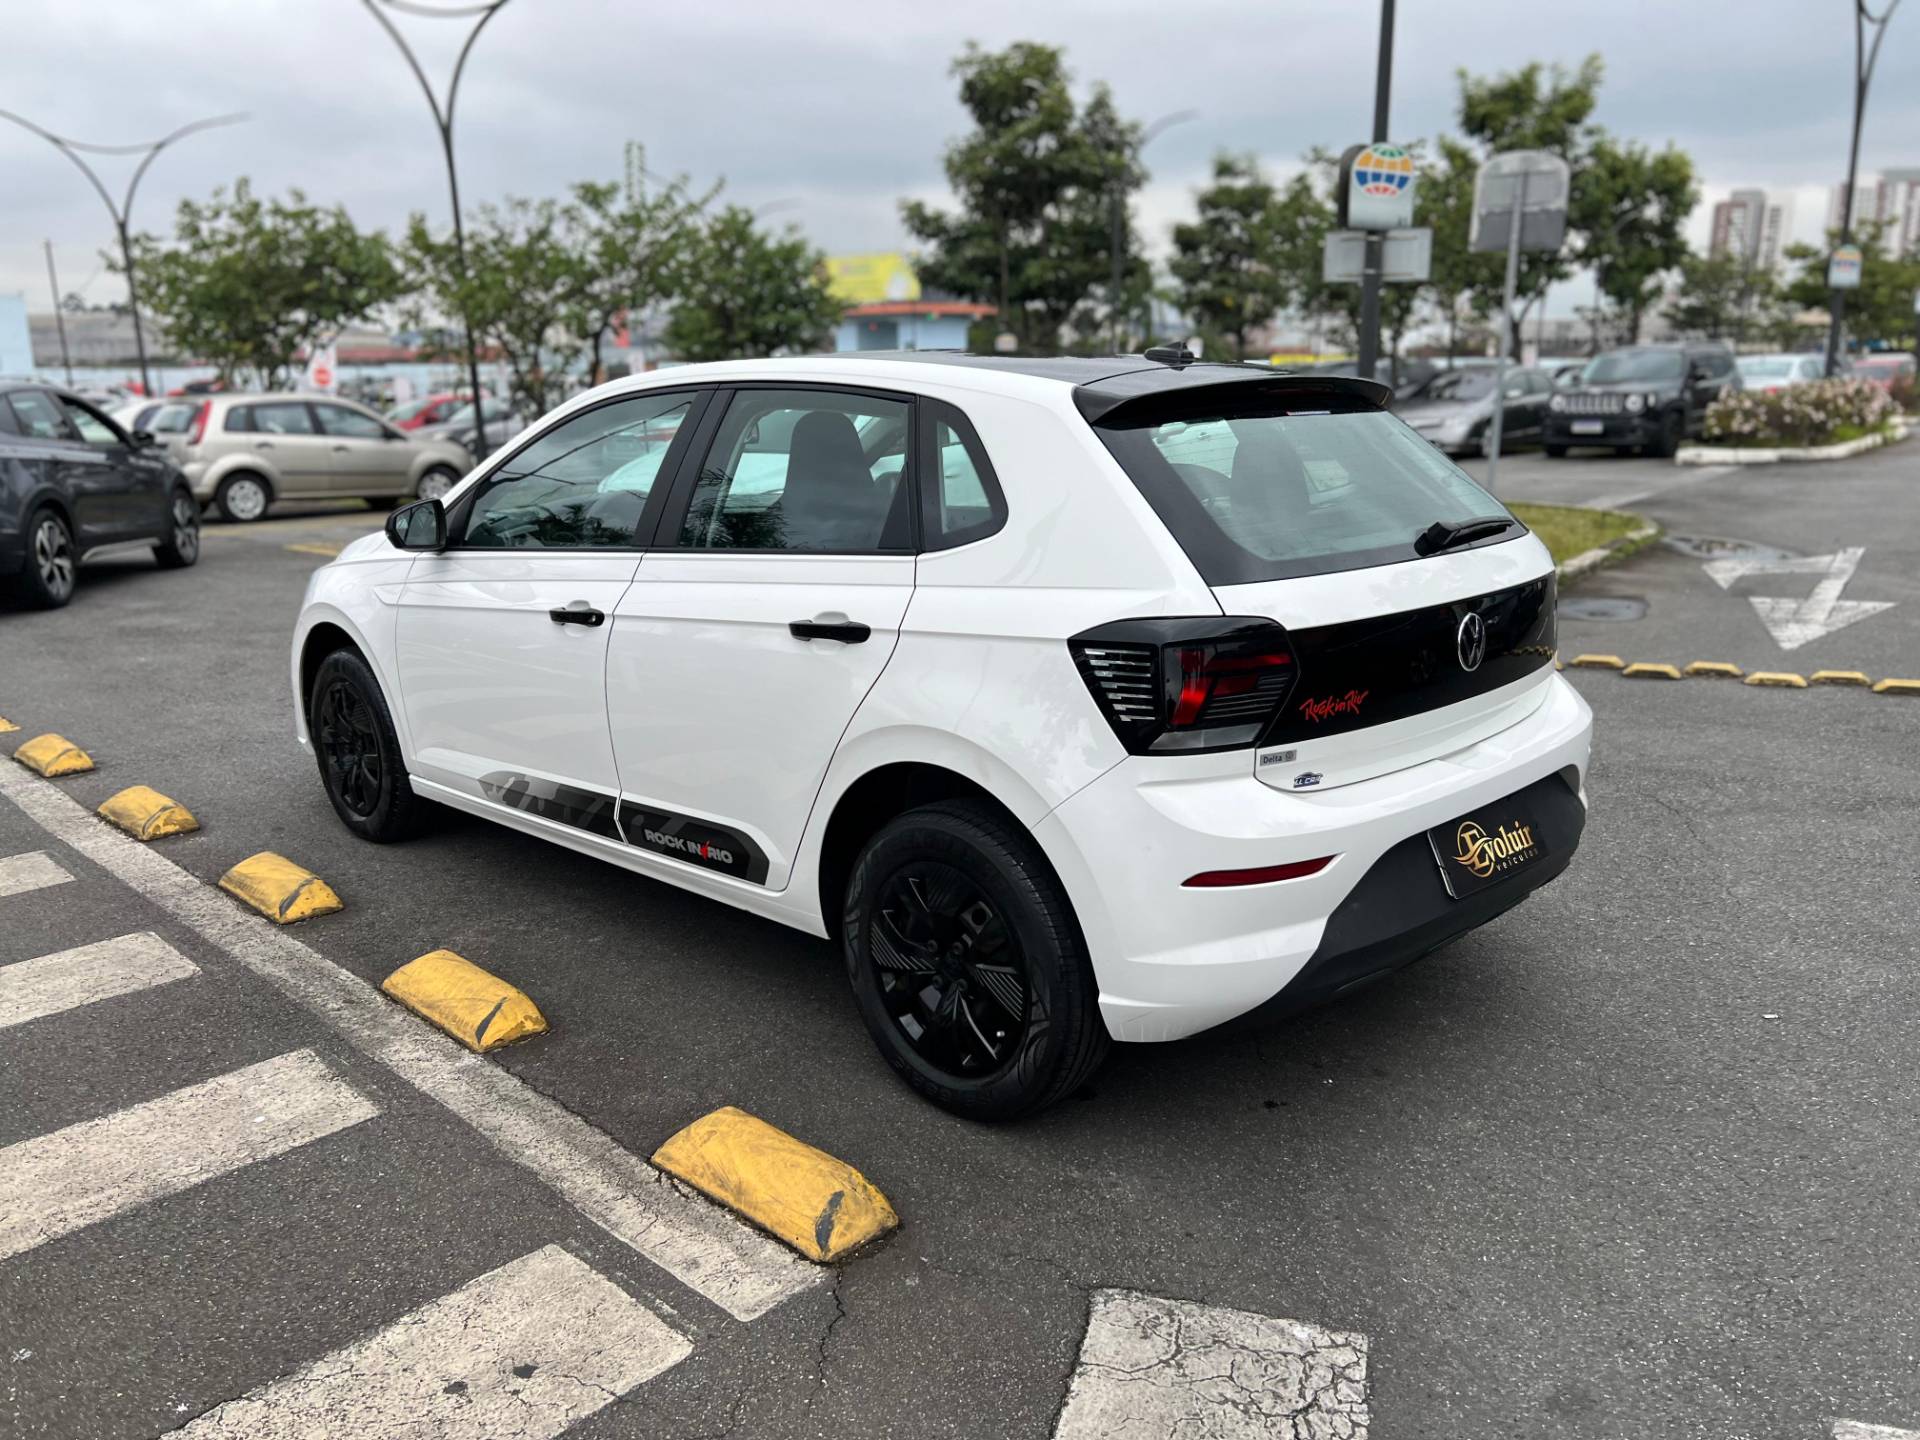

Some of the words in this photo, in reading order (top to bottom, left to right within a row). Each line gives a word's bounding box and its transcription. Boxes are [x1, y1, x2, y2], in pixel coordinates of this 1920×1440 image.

[1299, 696, 1336, 722] Rock
[1335, 698, 1346, 712] in
[1344, 690, 1369, 714] Rio
[1263, 754, 1283, 764] Delta
[644, 828, 687, 852] ROCK
[686, 840, 702, 856] IN
[707, 846, 733, 864] RIO
[1460, 820, 1535, 870] Evoluir
